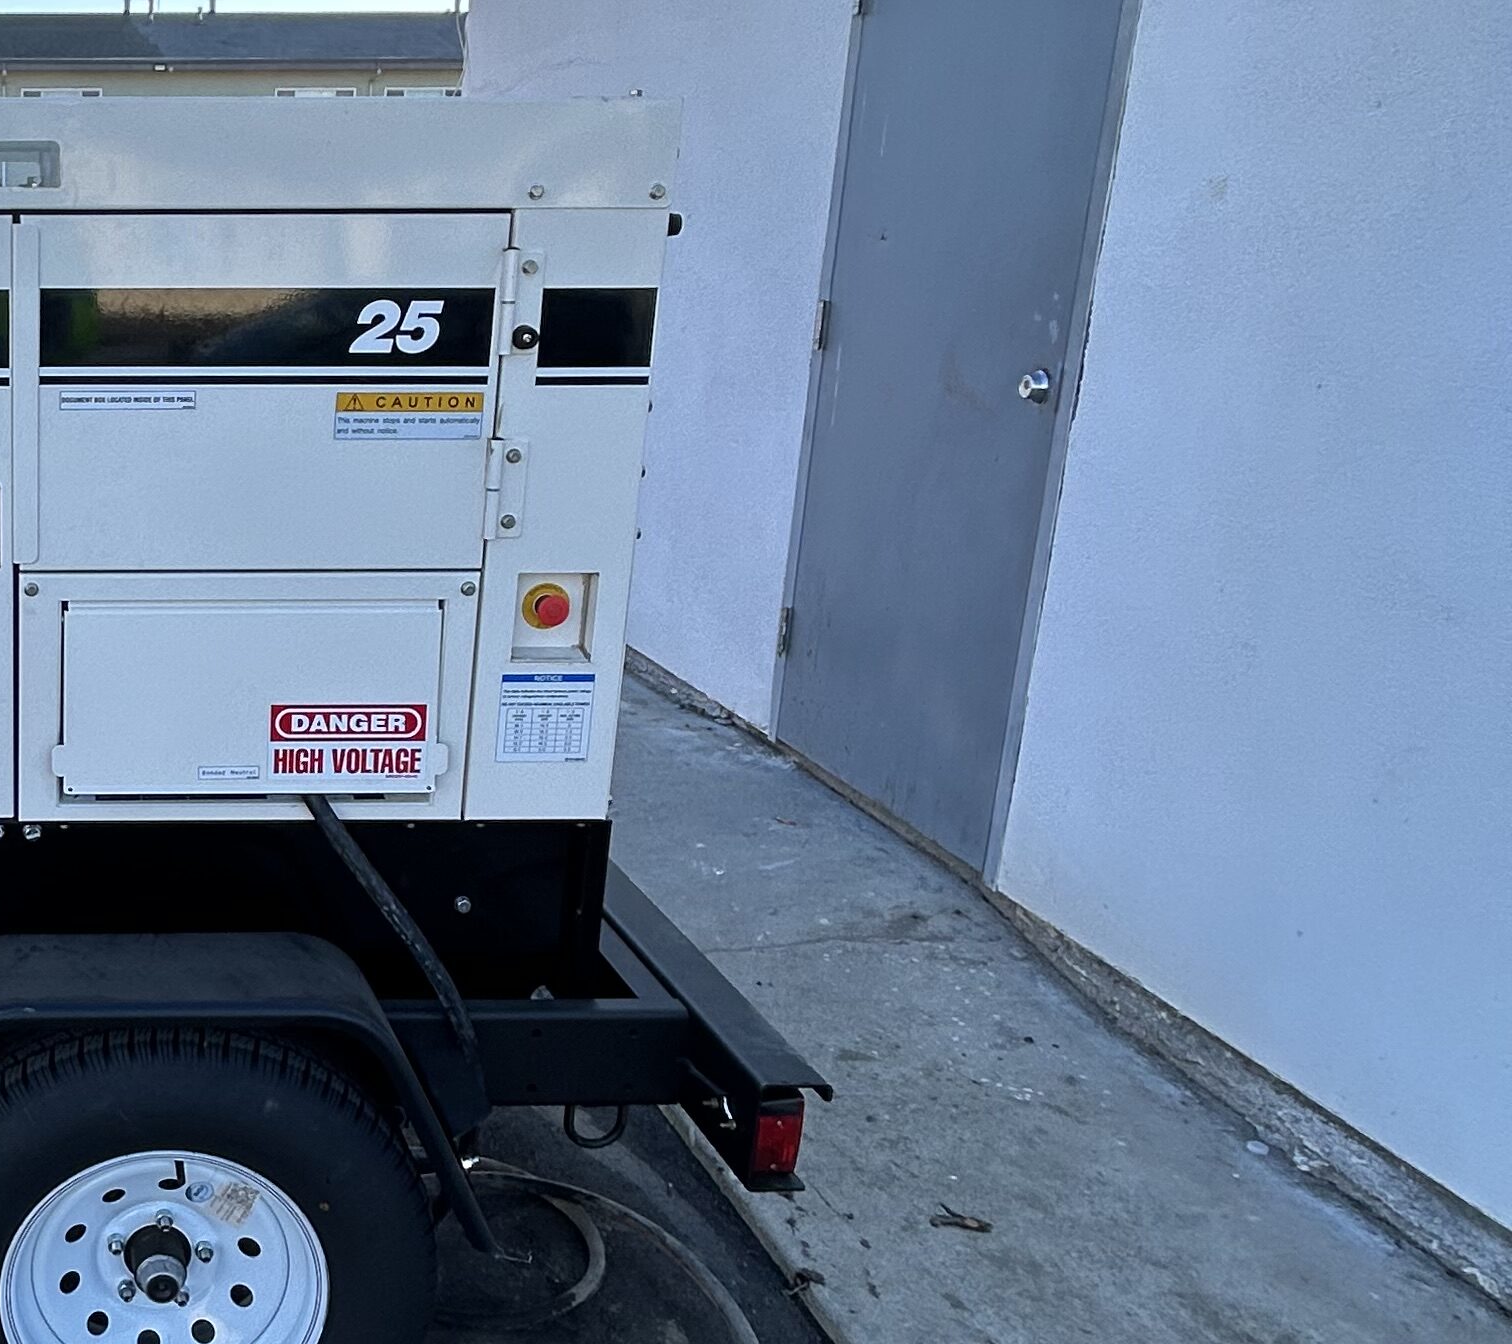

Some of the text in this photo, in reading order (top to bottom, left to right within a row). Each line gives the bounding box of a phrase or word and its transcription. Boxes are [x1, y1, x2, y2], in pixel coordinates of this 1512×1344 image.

[348, 299, 445, 354] 25
[375, 396, 476, 408] CAUTION
[290, 714, 406, 732] DANGER
[273, 748, 422, 775] HIGH VOLTAGE
